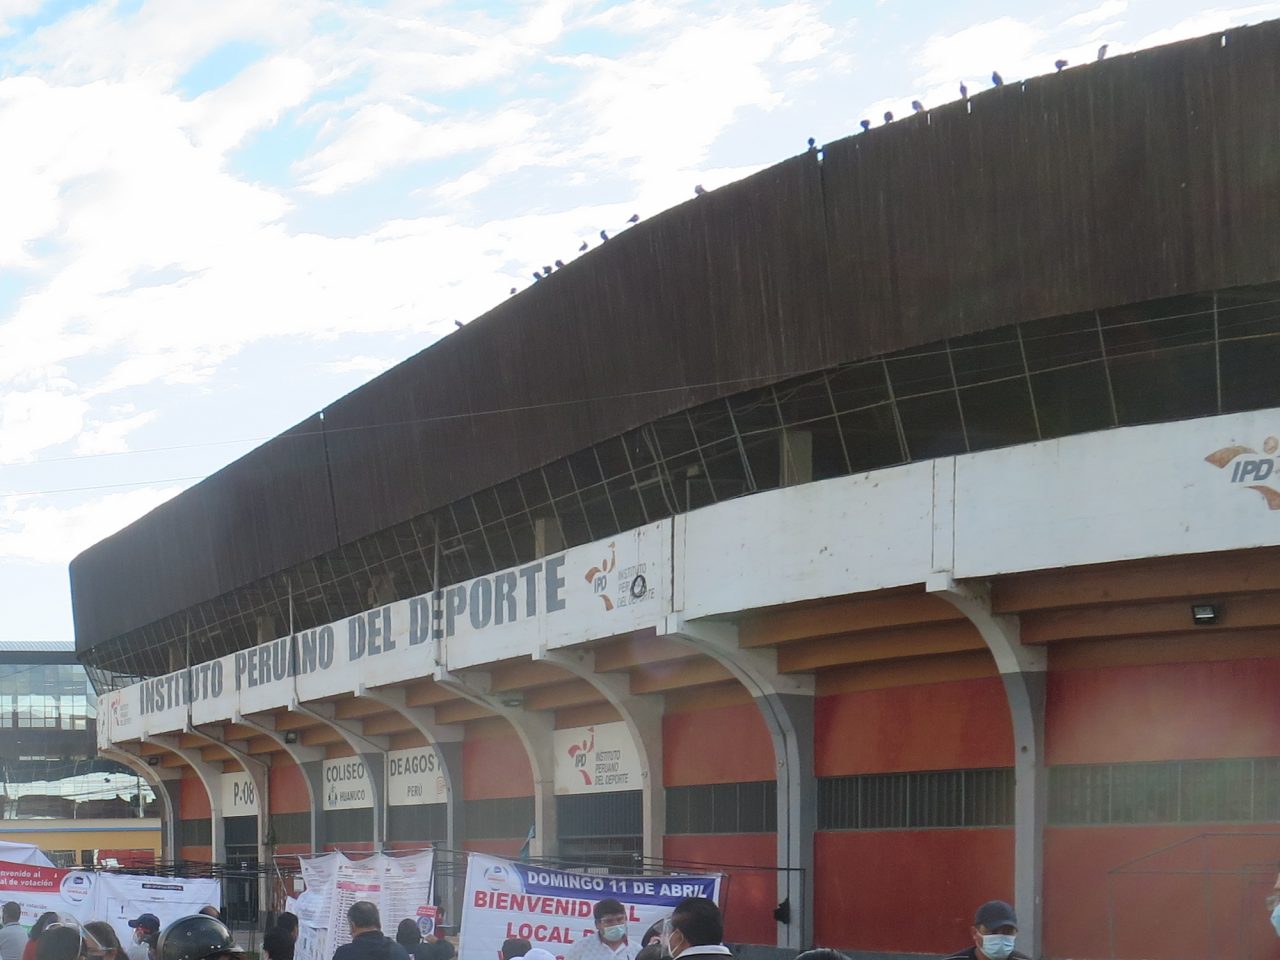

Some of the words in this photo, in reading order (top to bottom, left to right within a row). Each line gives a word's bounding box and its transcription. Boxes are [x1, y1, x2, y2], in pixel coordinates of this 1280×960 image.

[1231, 458, 1275, 483] IPD
[593, 574, 608, 594] IPD
[139, 659, 224, 716] INSTITUTO
[234, 625, 335, 691] PERUANO
[347, 605, 396, 662] DEL
[408, 555, 567, 647] DEPORTE
[574, 753, 588, 768] IPD
[595, 750, 622, 762] INSTITUTO
[326, 761, 365, 783] COLISEO
[595, 762, 620, 774] PERUANO
[595, 775, 605, 786] DEL
[605, 773, 629, 784] DEPORTE
[8, 878, 18, 886] de
[20, 879, 54, 887] votación
[33, 870, 41, 878] al
[527, 871, 604, 892] DOMINGO
[609, 879, 627, 894] 11
[633, 881, 655, 895] DE
[659, 884, 707, 899] ABRIL
[474, 890, 593, 918] BIENVENID
[506, 922, 574, 945] LOCAL
